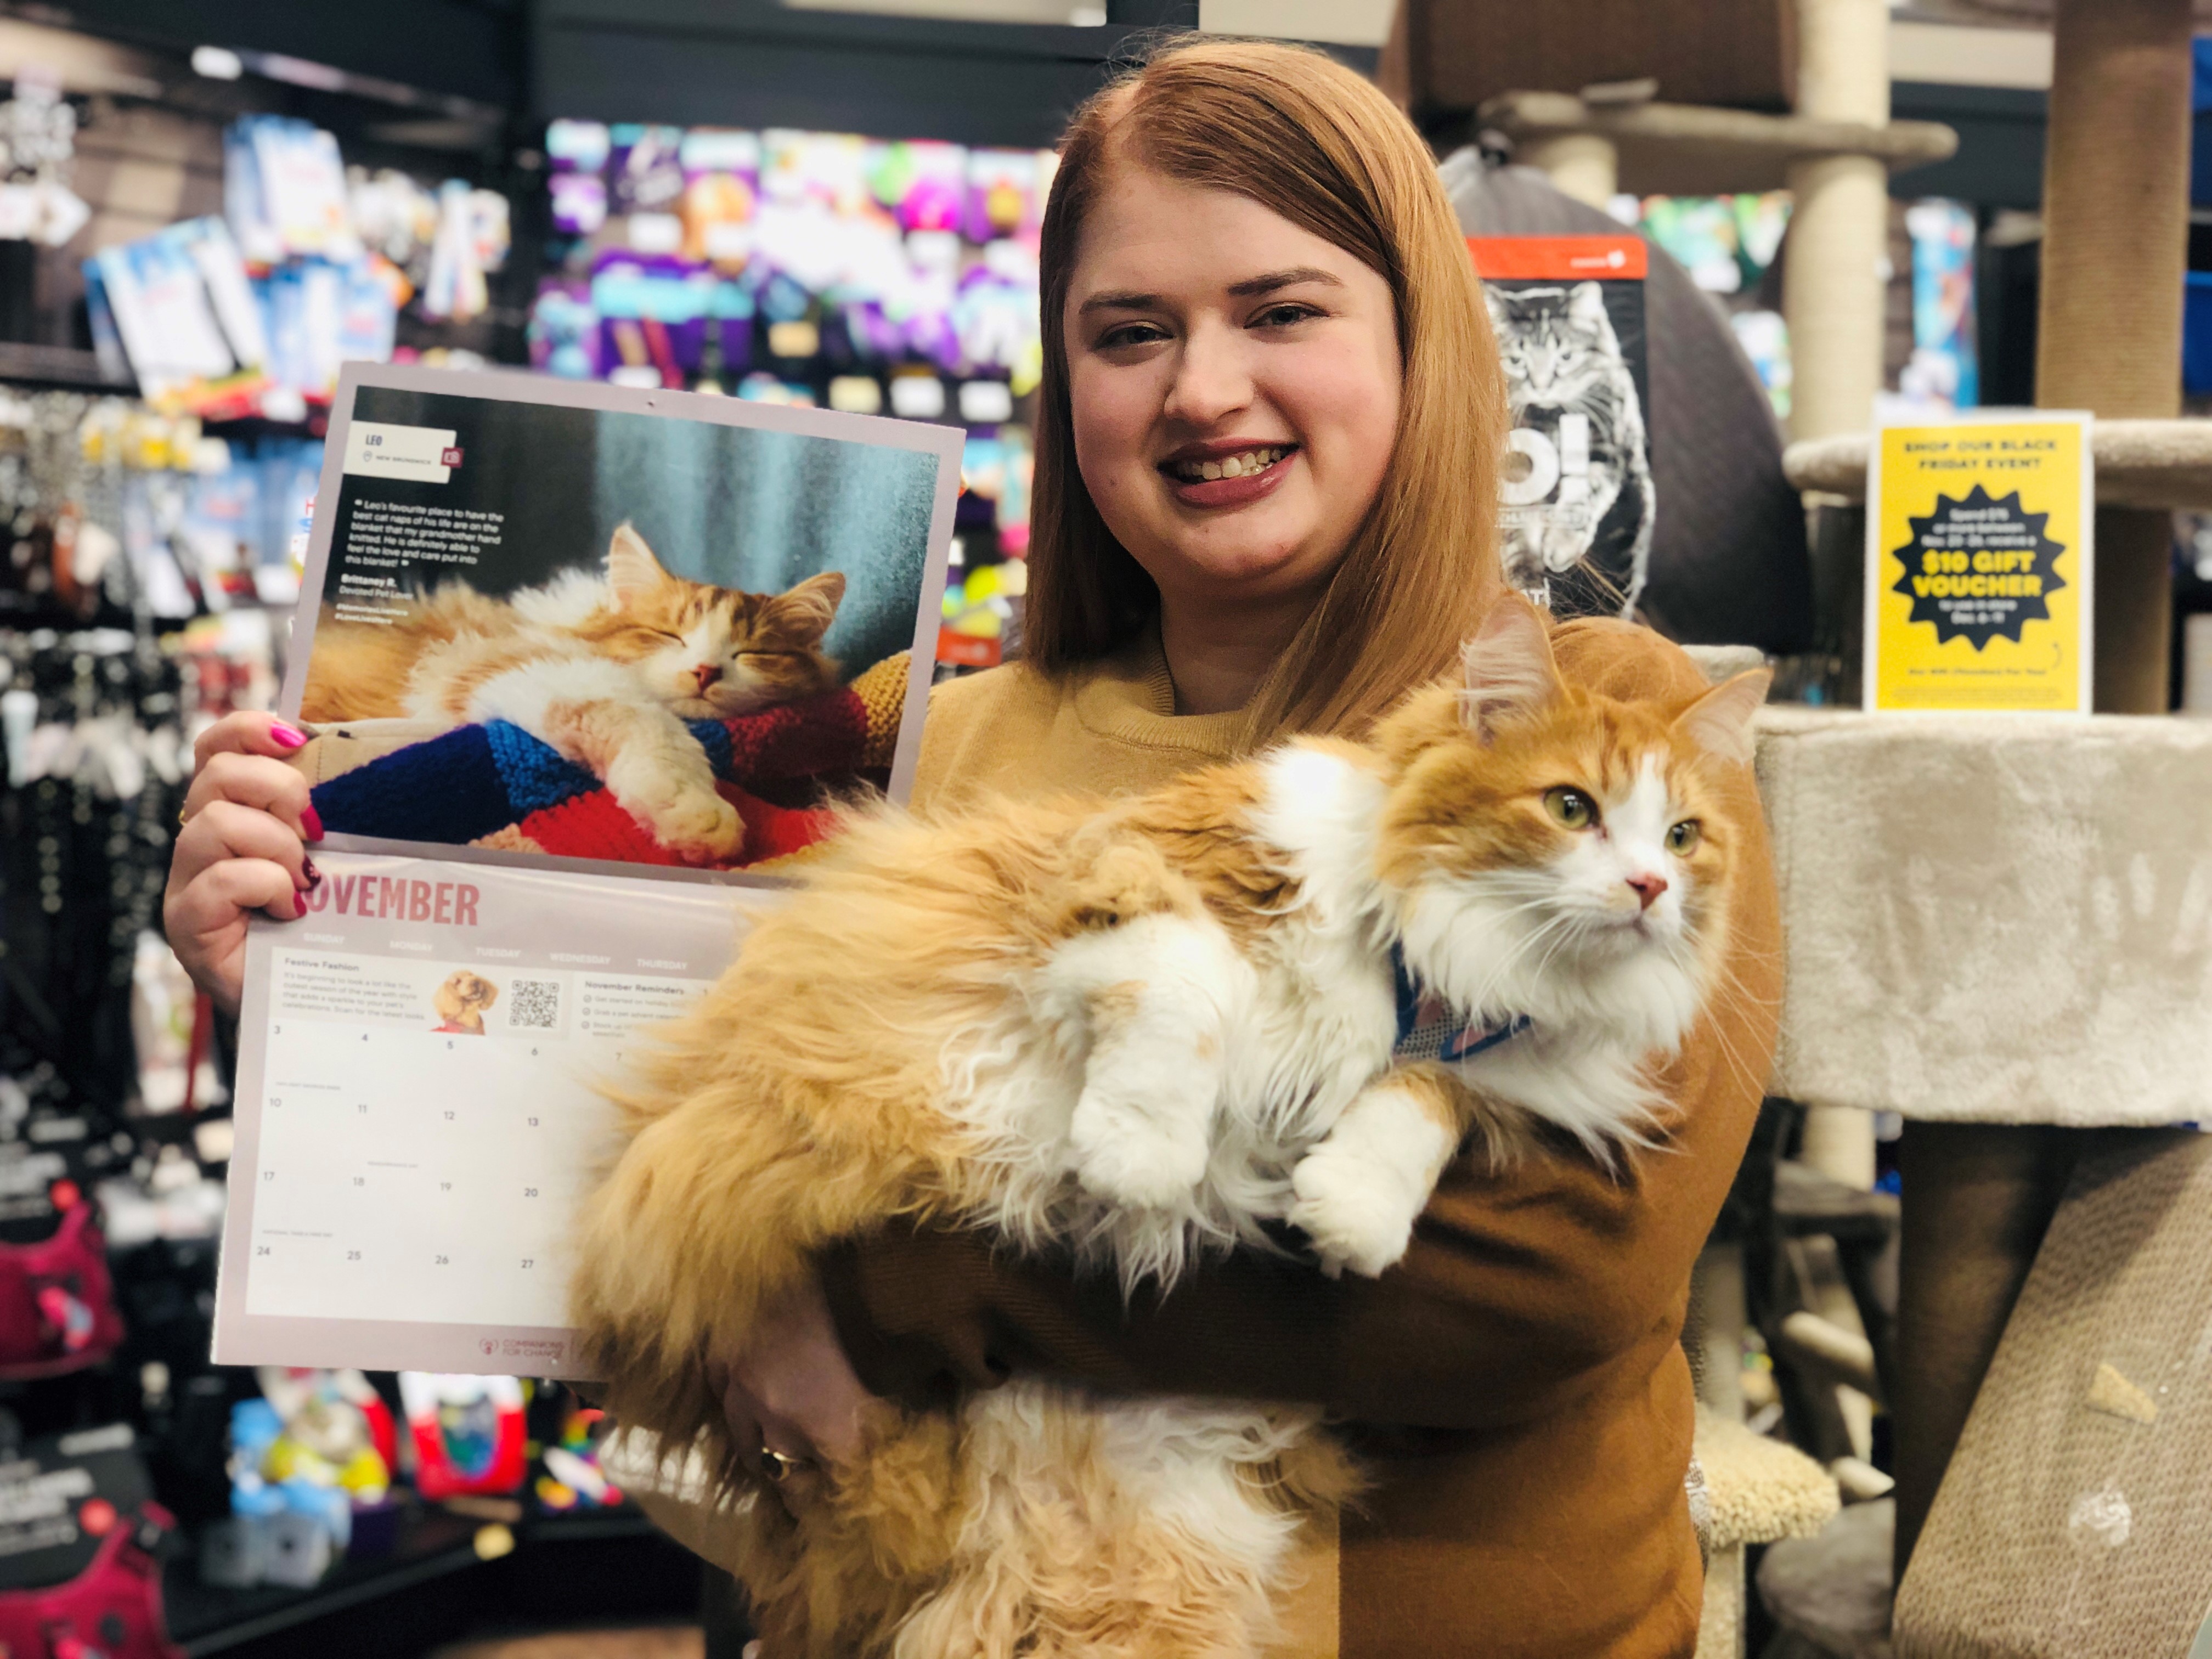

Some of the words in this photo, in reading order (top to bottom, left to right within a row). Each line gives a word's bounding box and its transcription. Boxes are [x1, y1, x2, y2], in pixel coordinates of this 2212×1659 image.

[365, 435, 382, 446] LEO
[1905, 441, 1950, 452] SHOP
[1957, 440, 1993, 451] OUR
[2001, 439, 2056, 451] BLACK
[392, 456, 431, 465] BRUNSWICK
[1920, 459, 1978, 470] FRIDAY
[1987, 458, 2042, 469] EVENT
[364, 500, 387, 511] Leo's
[388, 502, 427, 515] favourite
[427, 507, 453, 517] place
[454, 509, 464, 518] to
[465, 510, 487, 521] have
[488, 512, 504, 522] the
[353, 511, 373, 520] best
[390, 515, 411, 524] naps
[413, 517, 423, 525] of
[424, 517, 437, 527] his
[438, 518, 452, 528] life
[453, 521, 468, 530] are
[483, 523, 499, 533] the
[351, 522, 383, 533] blanket
[385, 525, 403, 534] that
[404, 528, 417, 537] my
[419, 529, 476, 542] grandmother
[477, 534, 501, 545] hand
[383, 536, 397, 546] He
[398, 538, 406, 546] is
[407, 538, 448, 551] definitely
[449, 543, 469, 553] able
[470, 545, 481, 554] to
[345, 555, 362, 565] this
[347, 543, 365, 554] feel
[365, 545, 381, 555] the
[382, 548, 401, 557] love
[402, 550, 420, 559] and
[420, 552, 441, 561] care
[441, 554, 458, 563] put
[459, 555, 478, 565] into
[1922, 548, 1970, 575] $10
[1972, 550, 2037, 574] GIFT
[341, 573, 386, 588] Brittaney
[1911, 574, 2043, 598] VOUCHER
[339, 585, 374, 597] Devoted
[375, 589, 390, 598] Pet
[390, 590, 414, 600] Lover
[303, 871, 480, 926] OVEMBER
[303, 932, 346, 945] SUNDAY
[390, 940, 434, 952] MONDAY
[475, 947, 522, 959] TUESDAY
[549, 952, 611, 966] WEDNESDAY
[636, 957, 688, 971] THURSDAY
[284, 957, 319, 968] Festive
[322, 961, 360, 972] Fashion
[297, 973, 336, 984] beginning
[347, 978, 364, 986] look
[585, 980, 633, 992] November
[635, 984, 685, 996] Reminders
[283, 981, 308, 990] cutest
[310, 985, 337, 993] season
[348, 987, 362, 995] the
[399, 992, 417, 1001] style
[283, 991, 298, 1000] that
[300, 993, 319, 1002] adds
[328, 996, 355, 1006] sparkle
[366, 1000, 385, 1008] your
[334, 1006, 354, 1014] Scan
[356, 1007, 366, 1015] for
[368, 1008, 381, 1017] the
[382, 1010, 403, 1019] latest
[594, 1008, 610, 1017] Grab
[631, 1012, 654, 1020] advent
[274, 1025, 281, 1035] 3
[447, 1040, 454, 1049] 5
[531, 1047, 538, 1056] 6
[616, 1052, 622, 1060] 7
[269, 1097, 282, 1108] 10
[358, 1104, 367, 1113] 11
[444, 1111, 455, 1120] 12
[528, 1117, 539, 1127] 13
[263, 1171, 275, 1181] 17
[353, 1177, 365, 1187] 18
[440, 1182, 452, 1191] 19
[524, 1188, 538, 1198] 20
[257, 1246, 270, 1256] 24
[347, 1250, 362, 1261] 25
[435, 1255, 449, 1265] 26
[521, 1259, 534, 1269] 27
[503, 1347, 521, 1356] FOR
